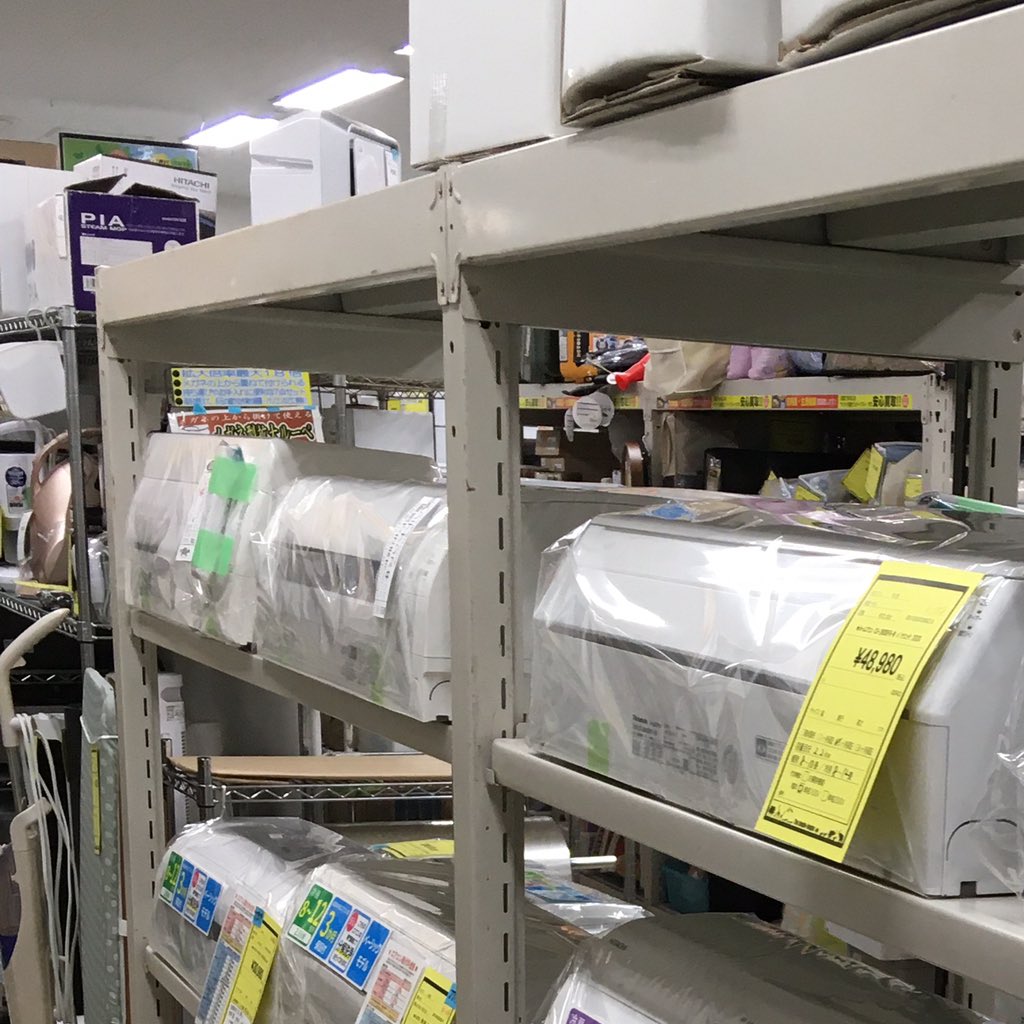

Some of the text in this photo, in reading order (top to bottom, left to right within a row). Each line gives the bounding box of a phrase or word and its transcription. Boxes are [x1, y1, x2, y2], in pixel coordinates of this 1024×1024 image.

[173, 177, 210, 189] HITACHI
[80, 212, 125, 227] PIA
[854, 647, 903, 676] ¥48,980
